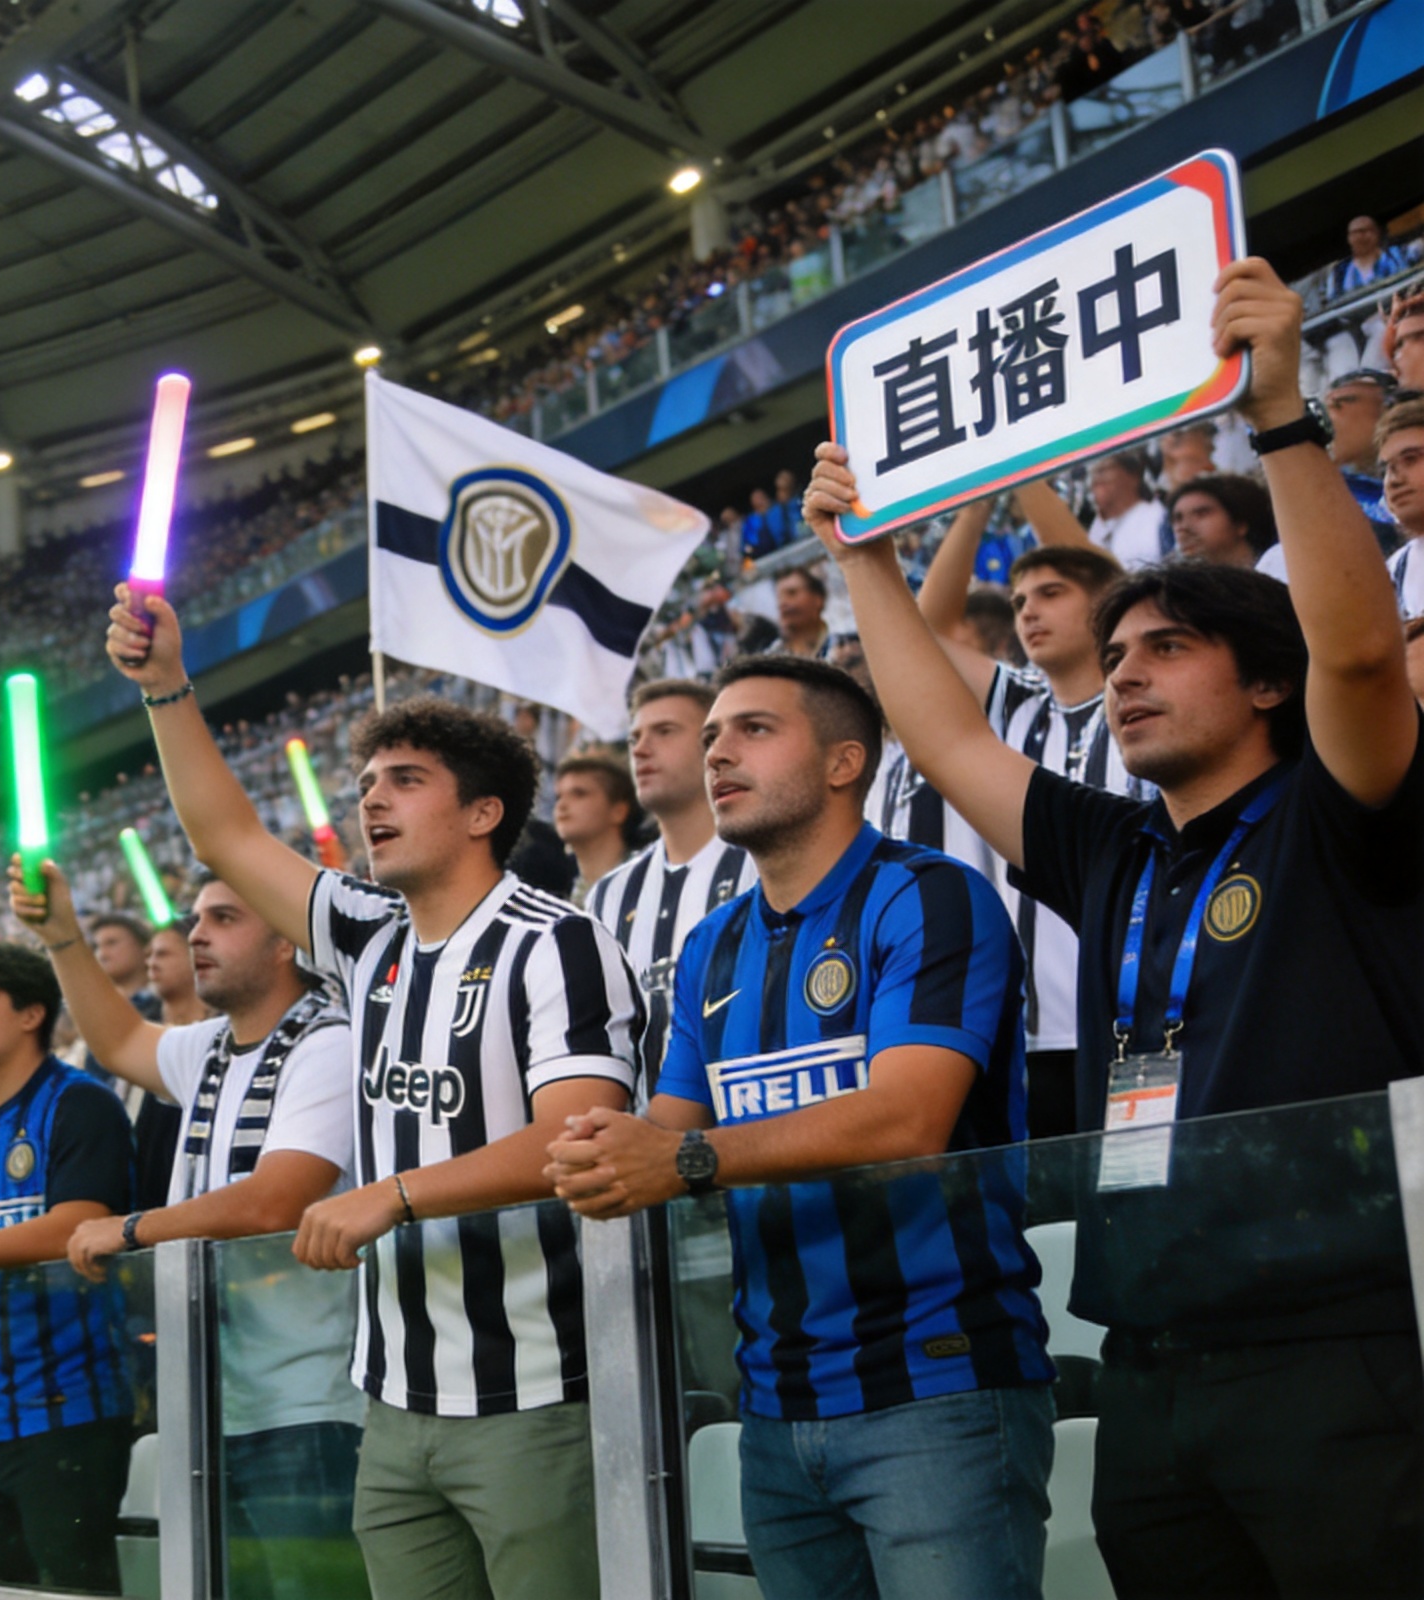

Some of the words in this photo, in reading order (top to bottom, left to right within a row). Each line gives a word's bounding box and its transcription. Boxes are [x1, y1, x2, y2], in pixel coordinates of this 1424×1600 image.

[873, 242, 1180, 477] 直播中
[363, 1044, 464, 1126] Jeep
